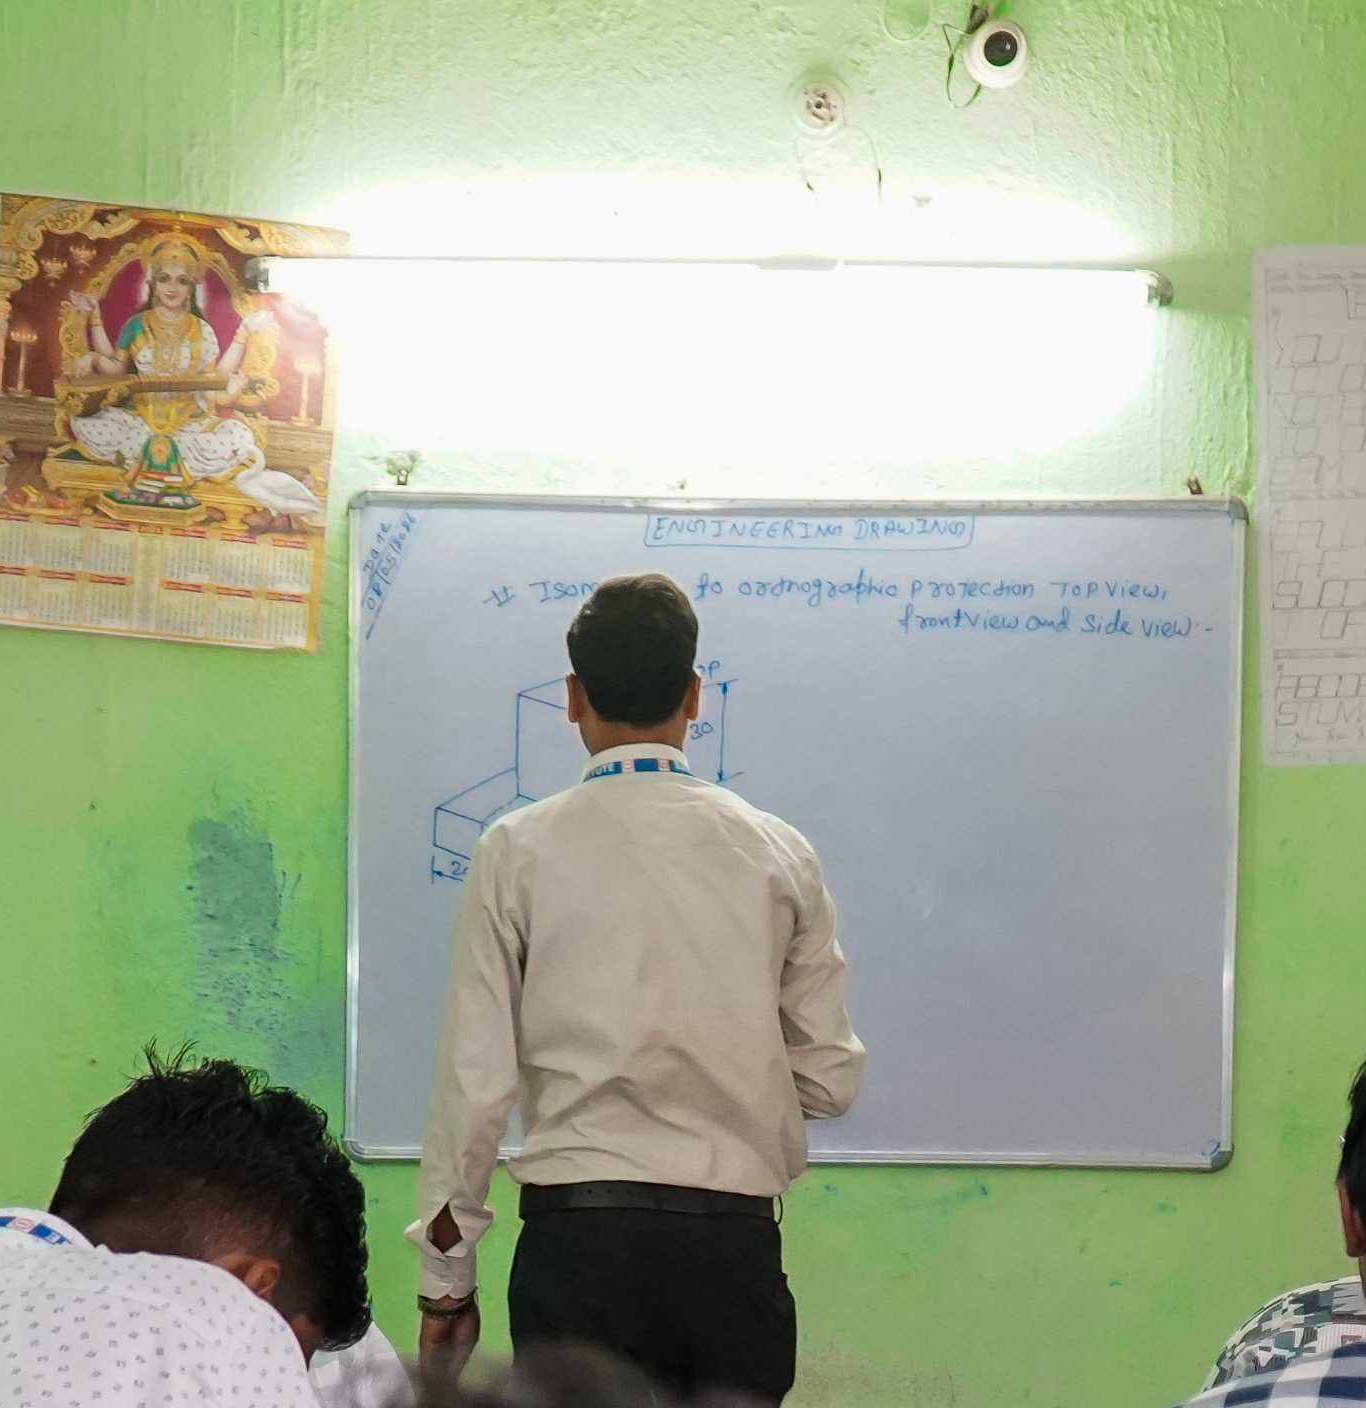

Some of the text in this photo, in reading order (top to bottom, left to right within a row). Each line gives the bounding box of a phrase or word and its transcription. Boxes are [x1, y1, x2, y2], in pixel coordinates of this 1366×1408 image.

[854, 518, 968, 541] DRAWING
[528, 580, 597, 603] Isom
[695, 573, 723, 600] to
[689, 721, 715, 740] 30
